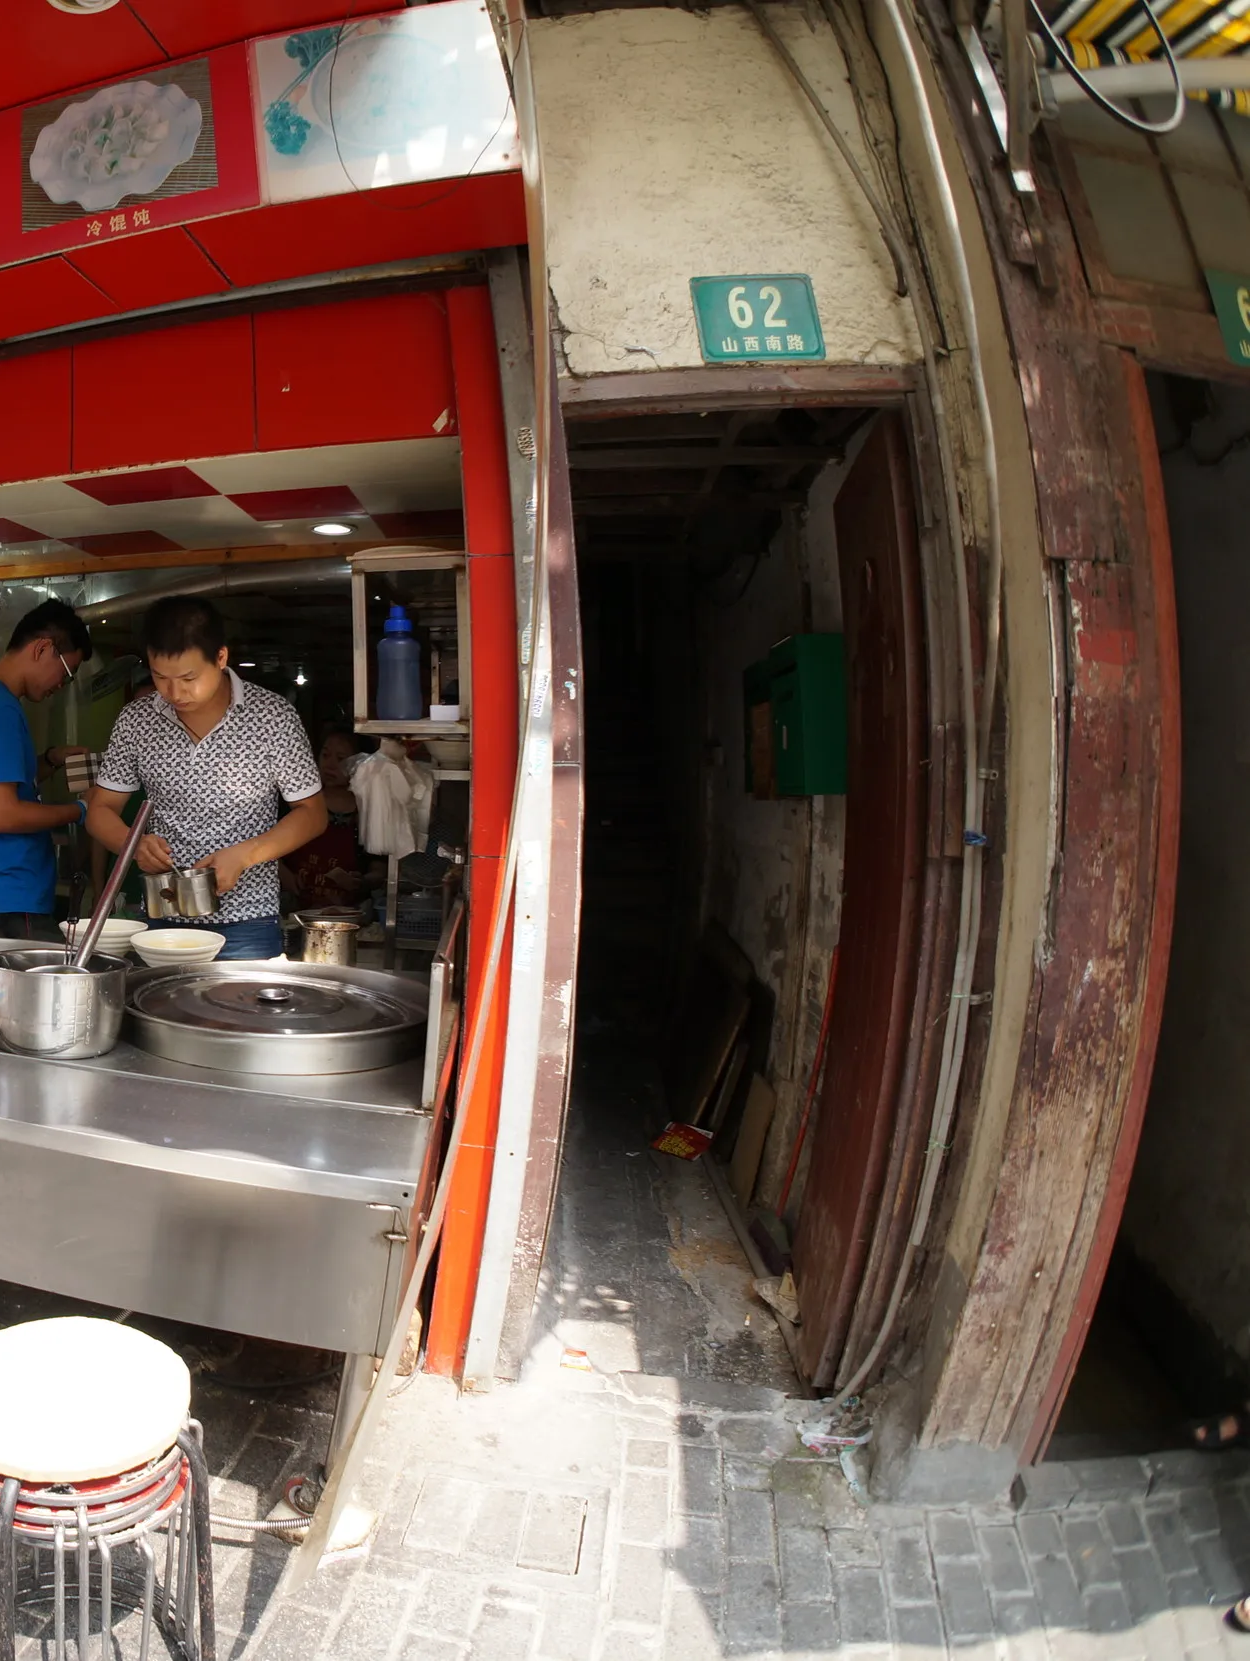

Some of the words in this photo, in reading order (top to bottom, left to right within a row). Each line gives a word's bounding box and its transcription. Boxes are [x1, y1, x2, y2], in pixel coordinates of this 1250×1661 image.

[86, 208, 151, 237] 冷馄饨
[727, 286, 787, 329] 62
[721, 333, 804, 353] 山西南路
